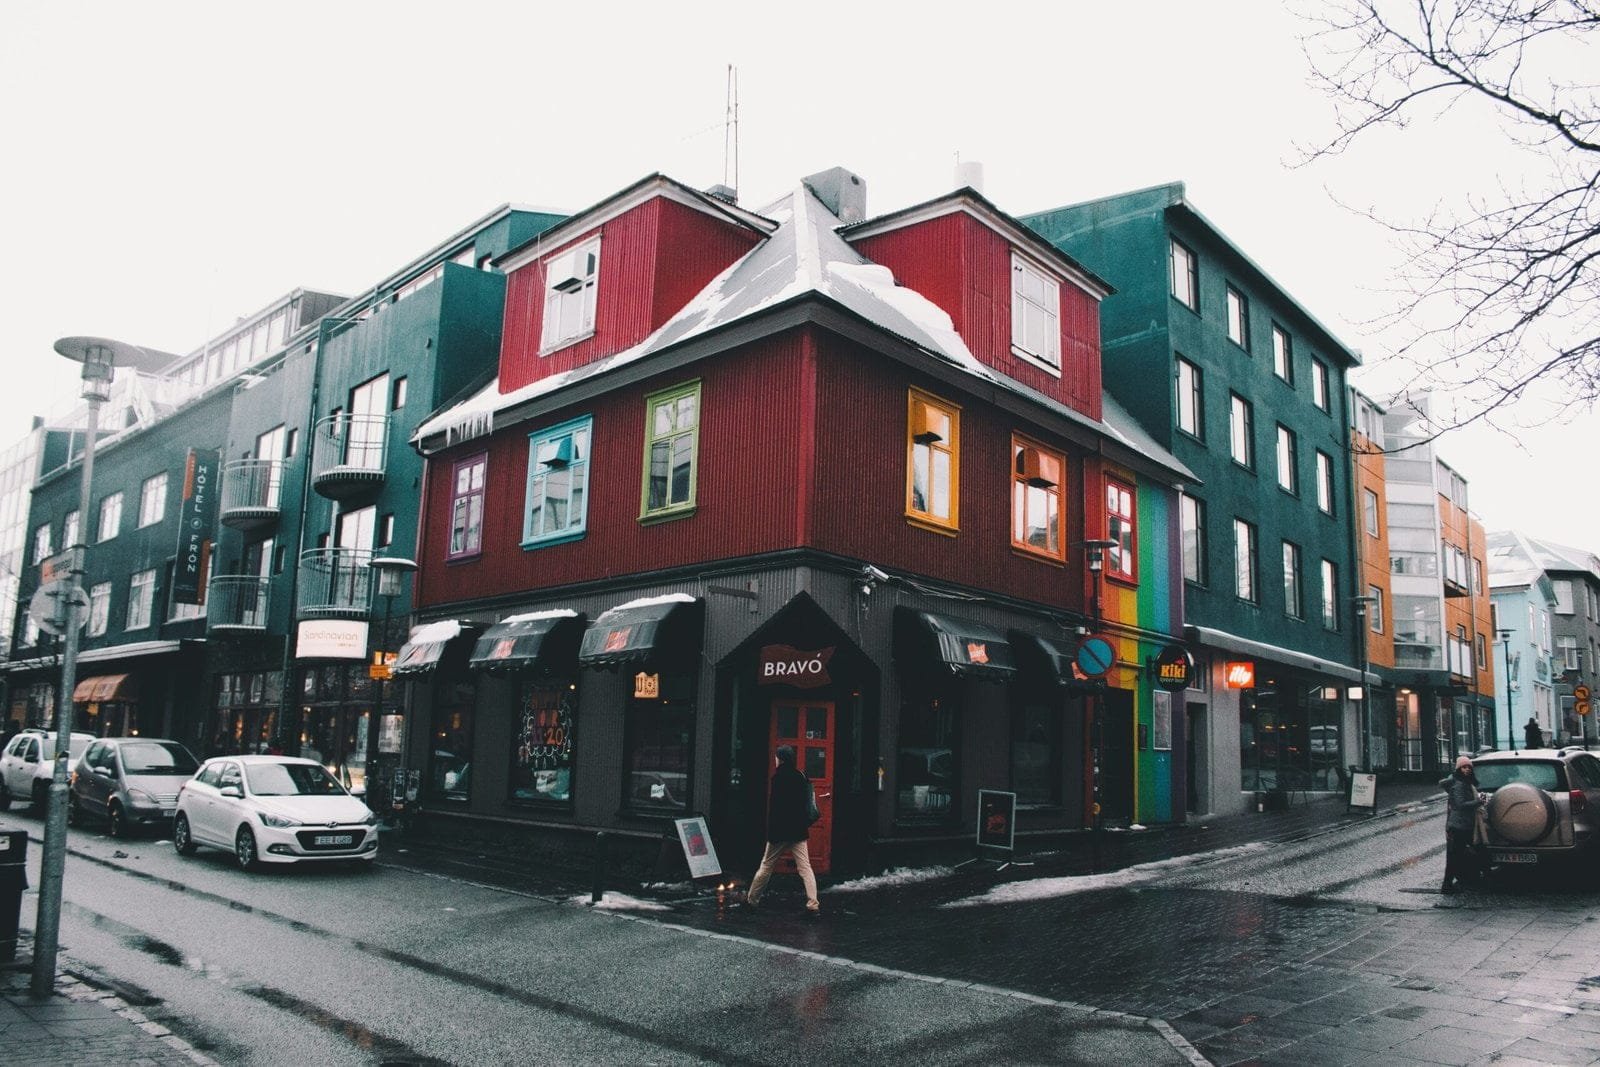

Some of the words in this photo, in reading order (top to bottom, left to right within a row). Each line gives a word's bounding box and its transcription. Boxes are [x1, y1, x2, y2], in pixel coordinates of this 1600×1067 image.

[764, 652, 822, 677] BRAVÓ
[1160, 664, 1186, 679] Kiki
[1229, 665, 1253, 686] illy
